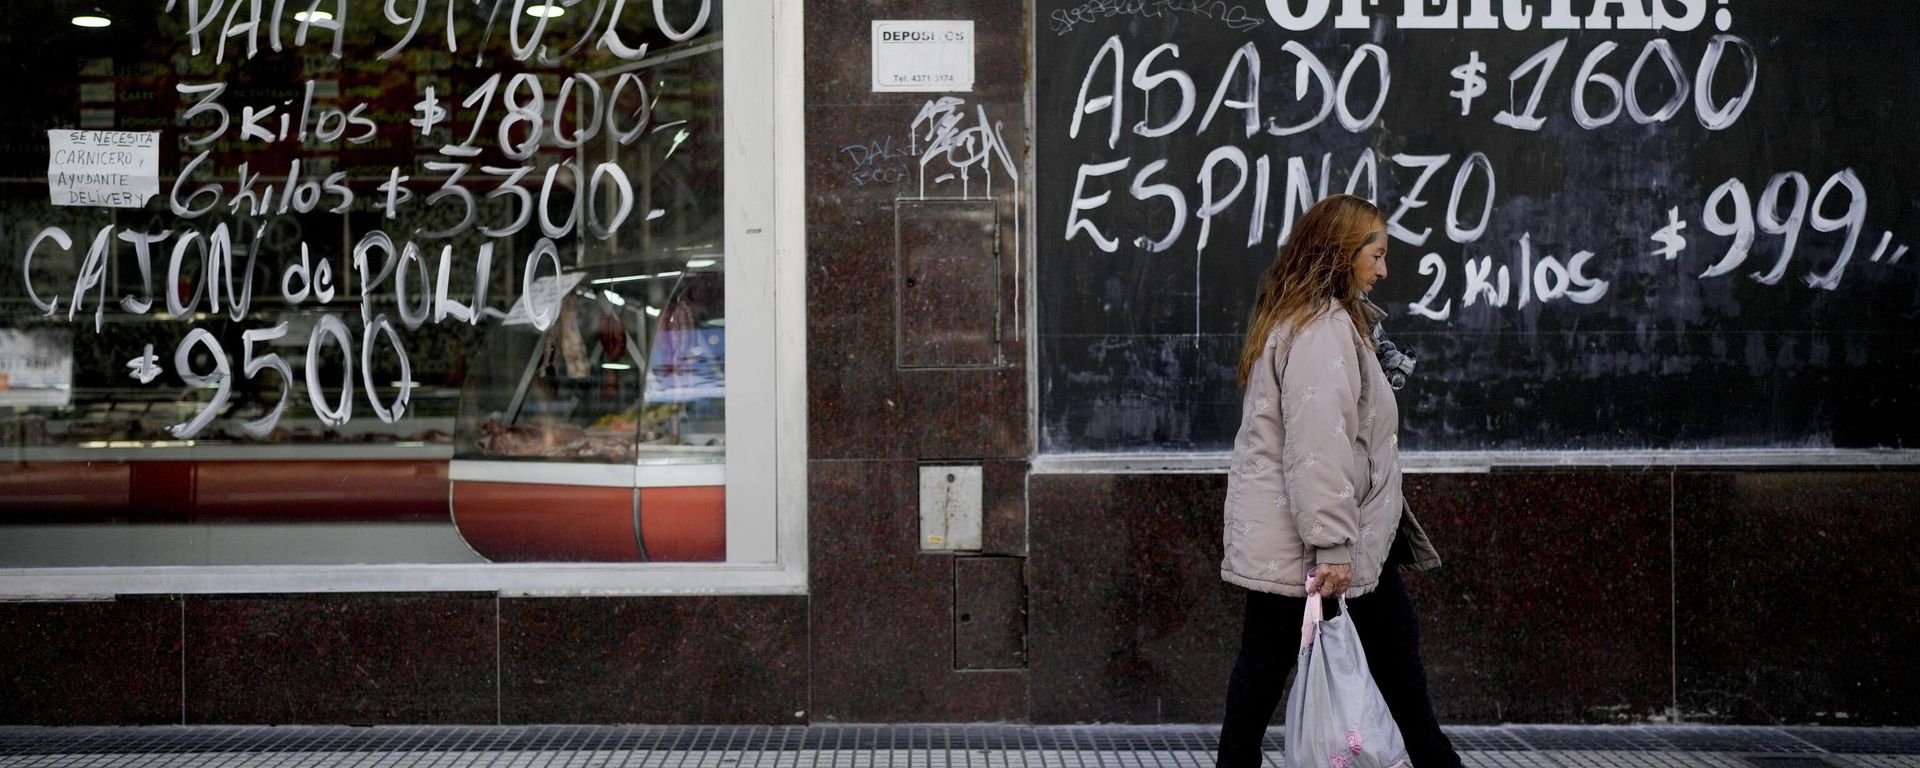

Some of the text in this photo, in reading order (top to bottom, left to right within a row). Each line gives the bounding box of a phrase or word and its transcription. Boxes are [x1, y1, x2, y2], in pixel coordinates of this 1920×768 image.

[883, 31, 965, 41] DEPOSIOS
[176, 80, 230, 146] 3
[1069, 34, 1392, 149] ASADO
[1449, 34, 1758, 131] $1600
[55, 150, 133, 166] CARNICERO
[70, 132, 153, 144] SE NECESITA
[58, 171, 129, 189] AYUDANTE
[170, 150, 224, 218] 6
[228, 158, 354, 216] kilos
[24, 219, 268, 334] CAJON
[282, 241, 335, 303] de
[353, 229, 563, 331] POLLO
[1408, 252, 1452, 321] 2
[127, 313, 411, 439] $9500
